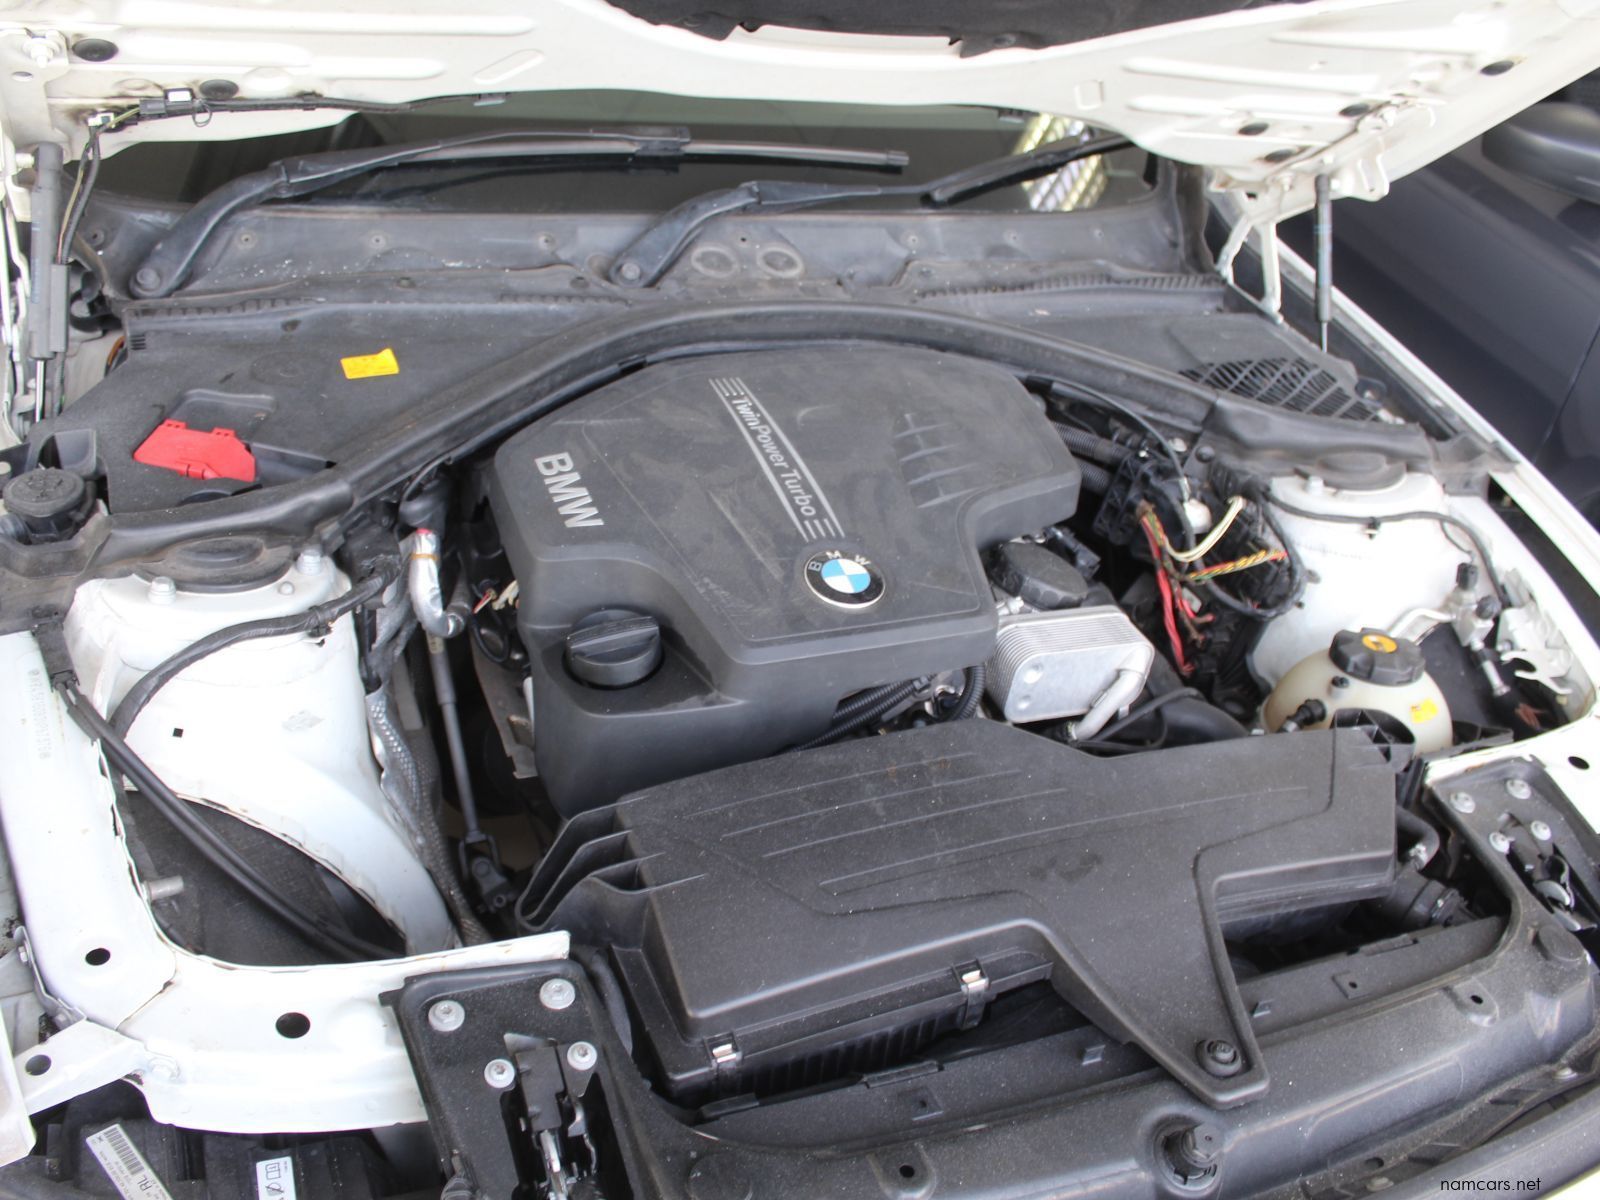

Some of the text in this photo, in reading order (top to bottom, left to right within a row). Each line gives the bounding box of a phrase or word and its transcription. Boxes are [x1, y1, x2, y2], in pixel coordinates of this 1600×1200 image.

[534, 452, 604, 528] BMW
[732, 397, 816, 516] TwinPower Turbo
[808, 550, 871, 572] BMW
